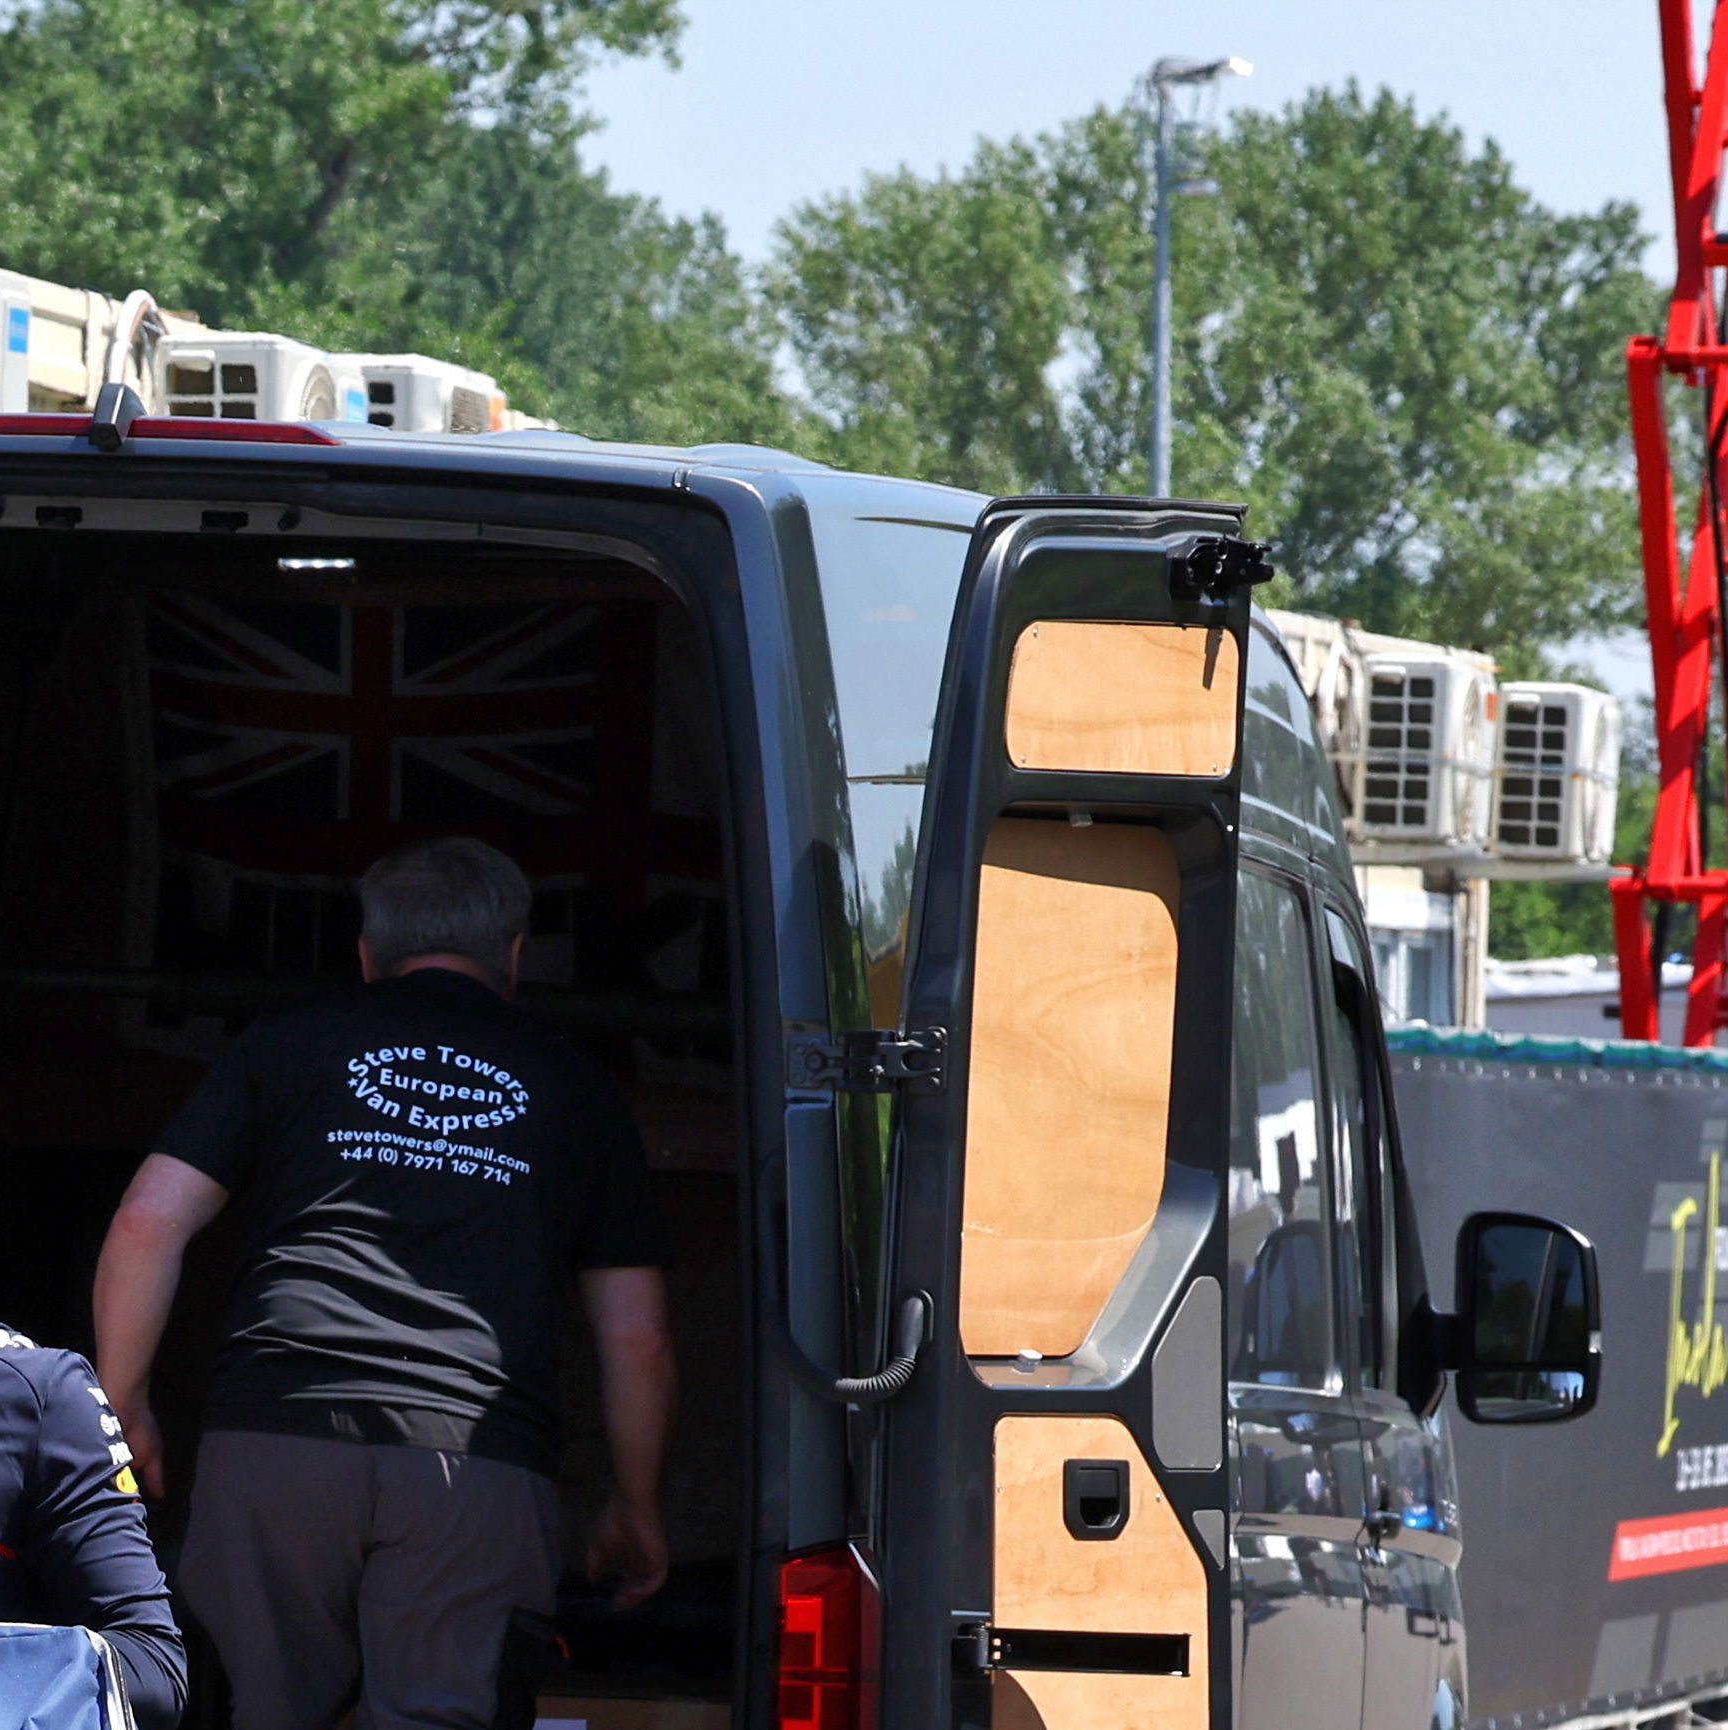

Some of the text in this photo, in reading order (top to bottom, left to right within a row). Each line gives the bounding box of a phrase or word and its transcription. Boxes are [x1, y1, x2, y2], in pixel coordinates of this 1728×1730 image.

[348, 1045, 529, 1103] Steve Towers
[379, 1068, 503, 1105] European
[355, 1077, 517, 1136] Van Express
[327, 1129, 531, 1174] stevetowers@ymail.com
[340, 1146, 512, 1186] +44 (0) 7971 167 714
